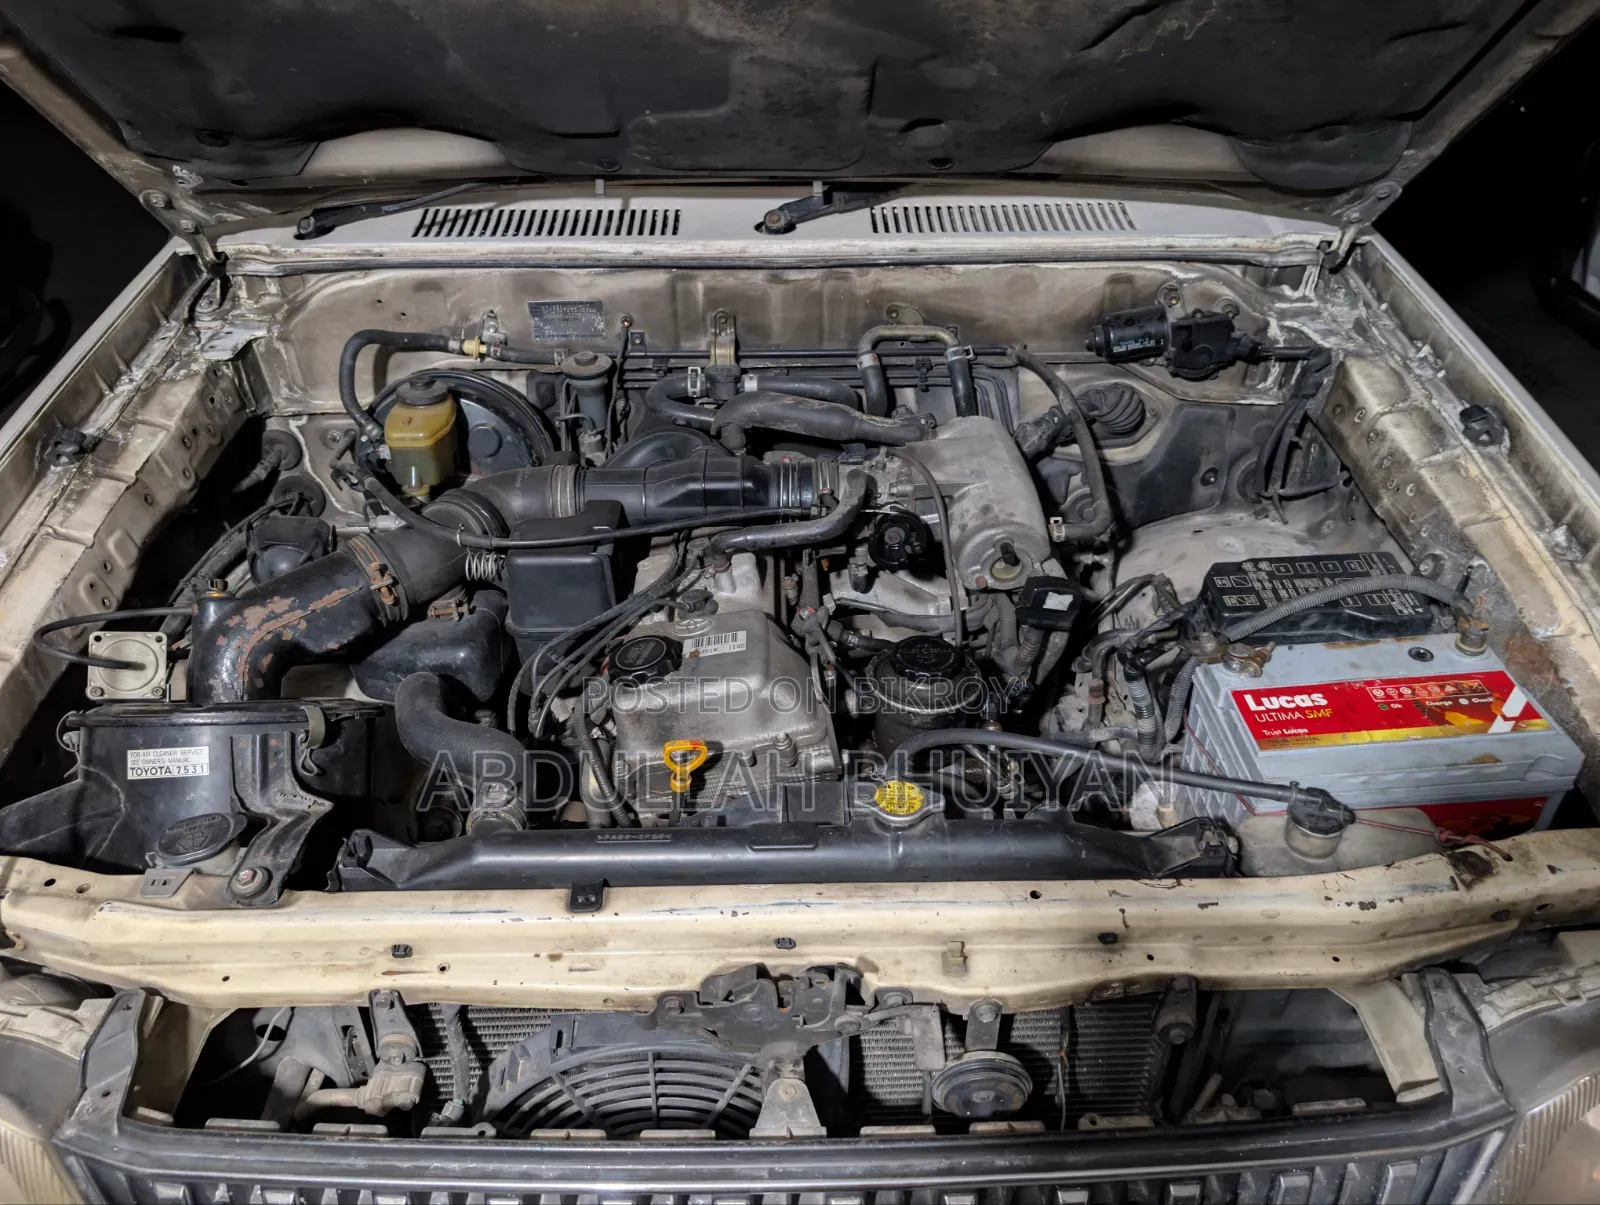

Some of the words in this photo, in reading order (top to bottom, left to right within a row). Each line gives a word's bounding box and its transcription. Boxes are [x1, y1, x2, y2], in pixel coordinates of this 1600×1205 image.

[1243, 693, 1328, 711] Lucas
[1255, 711, 1305, 723] ULTIMA
[1305, 708, 1333, 719] SMF
[1262, 728, 1282, 737] Trust
[152, 749, 178, 757] CLEANER
[129, 766, 172, 777] TOYOTA
[176, 765, 204, 775] 7531
